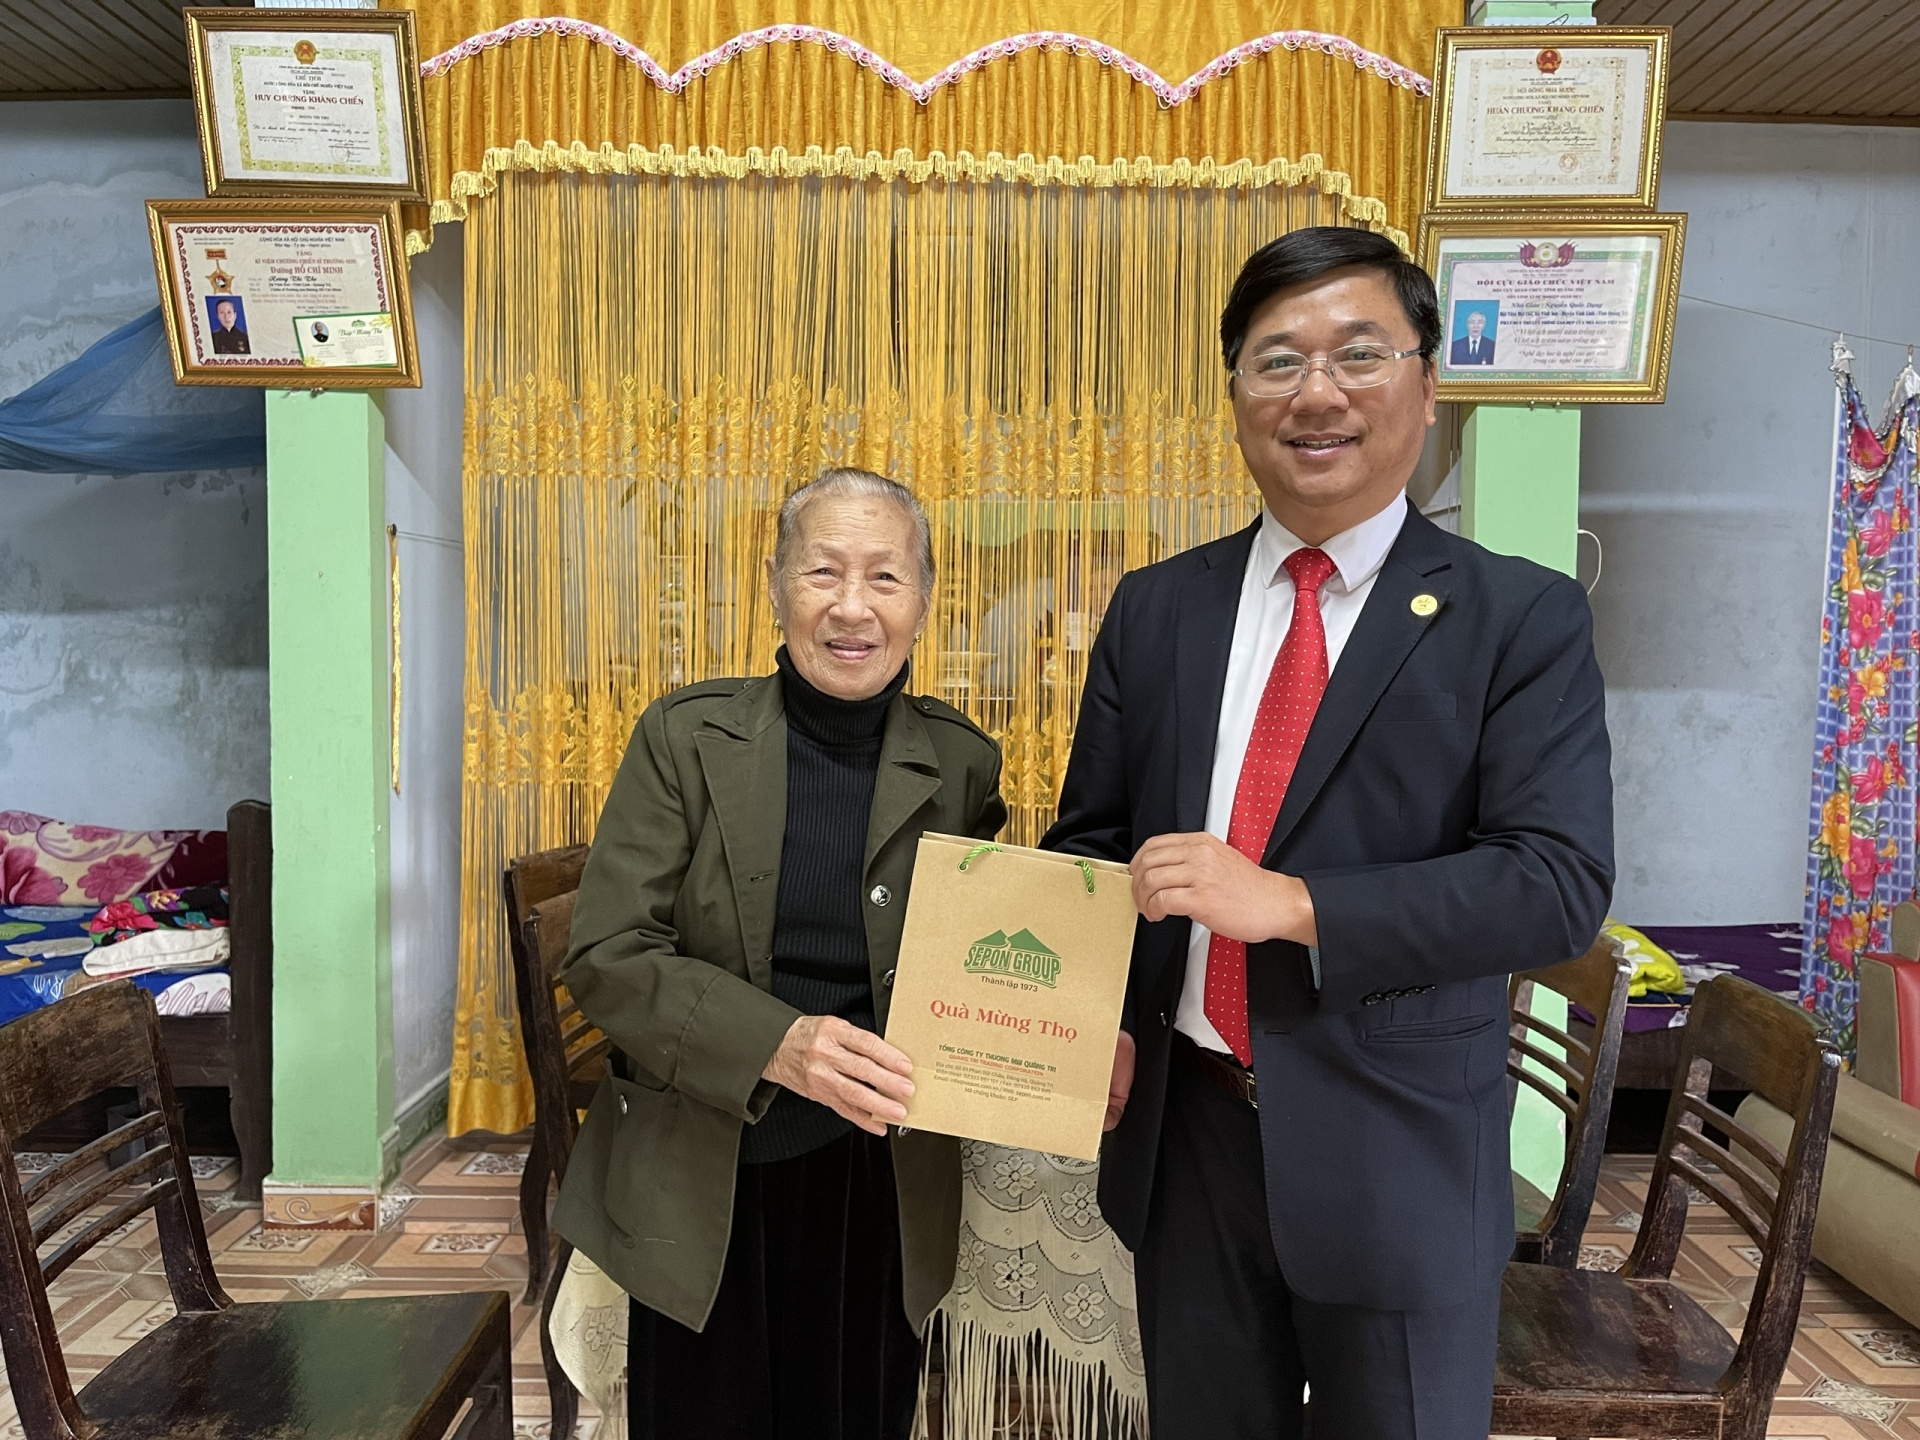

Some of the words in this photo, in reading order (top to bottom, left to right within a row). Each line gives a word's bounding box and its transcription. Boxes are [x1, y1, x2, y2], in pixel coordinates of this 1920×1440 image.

[340, 95, 364, 105] CHIẾN
[1511, 106, 1545, 114] CHƯƠNG
[1579, 105, 1605, 114] CHIẾN
[322, 266, 343, 274] MINH
[1543, 278, 1568, 286] CHỨC
[1570, 278, 1592, 286] VIỆT
[964, 945, 1012, 970] SEPON
[1013, 951, 1061, 983] GROUP
[981, 975, 1005, 986] Thành
[1006, 979, 1019, 989] lập
[1020, 983, 1038, 992] 1973
[930, 999, 970, 1019] Quà
[975, 1007, 1031, 1034] Mừng
[1038, 1019, 1078, 1043] Thọ
[957, 1046, 974, 1056] CÔNG
[976, 1050, 984, 1058] TY
[980, 1059, 1003, 1068] TRADING
[1004, 1064, 1044, 1076] CORPORATION
